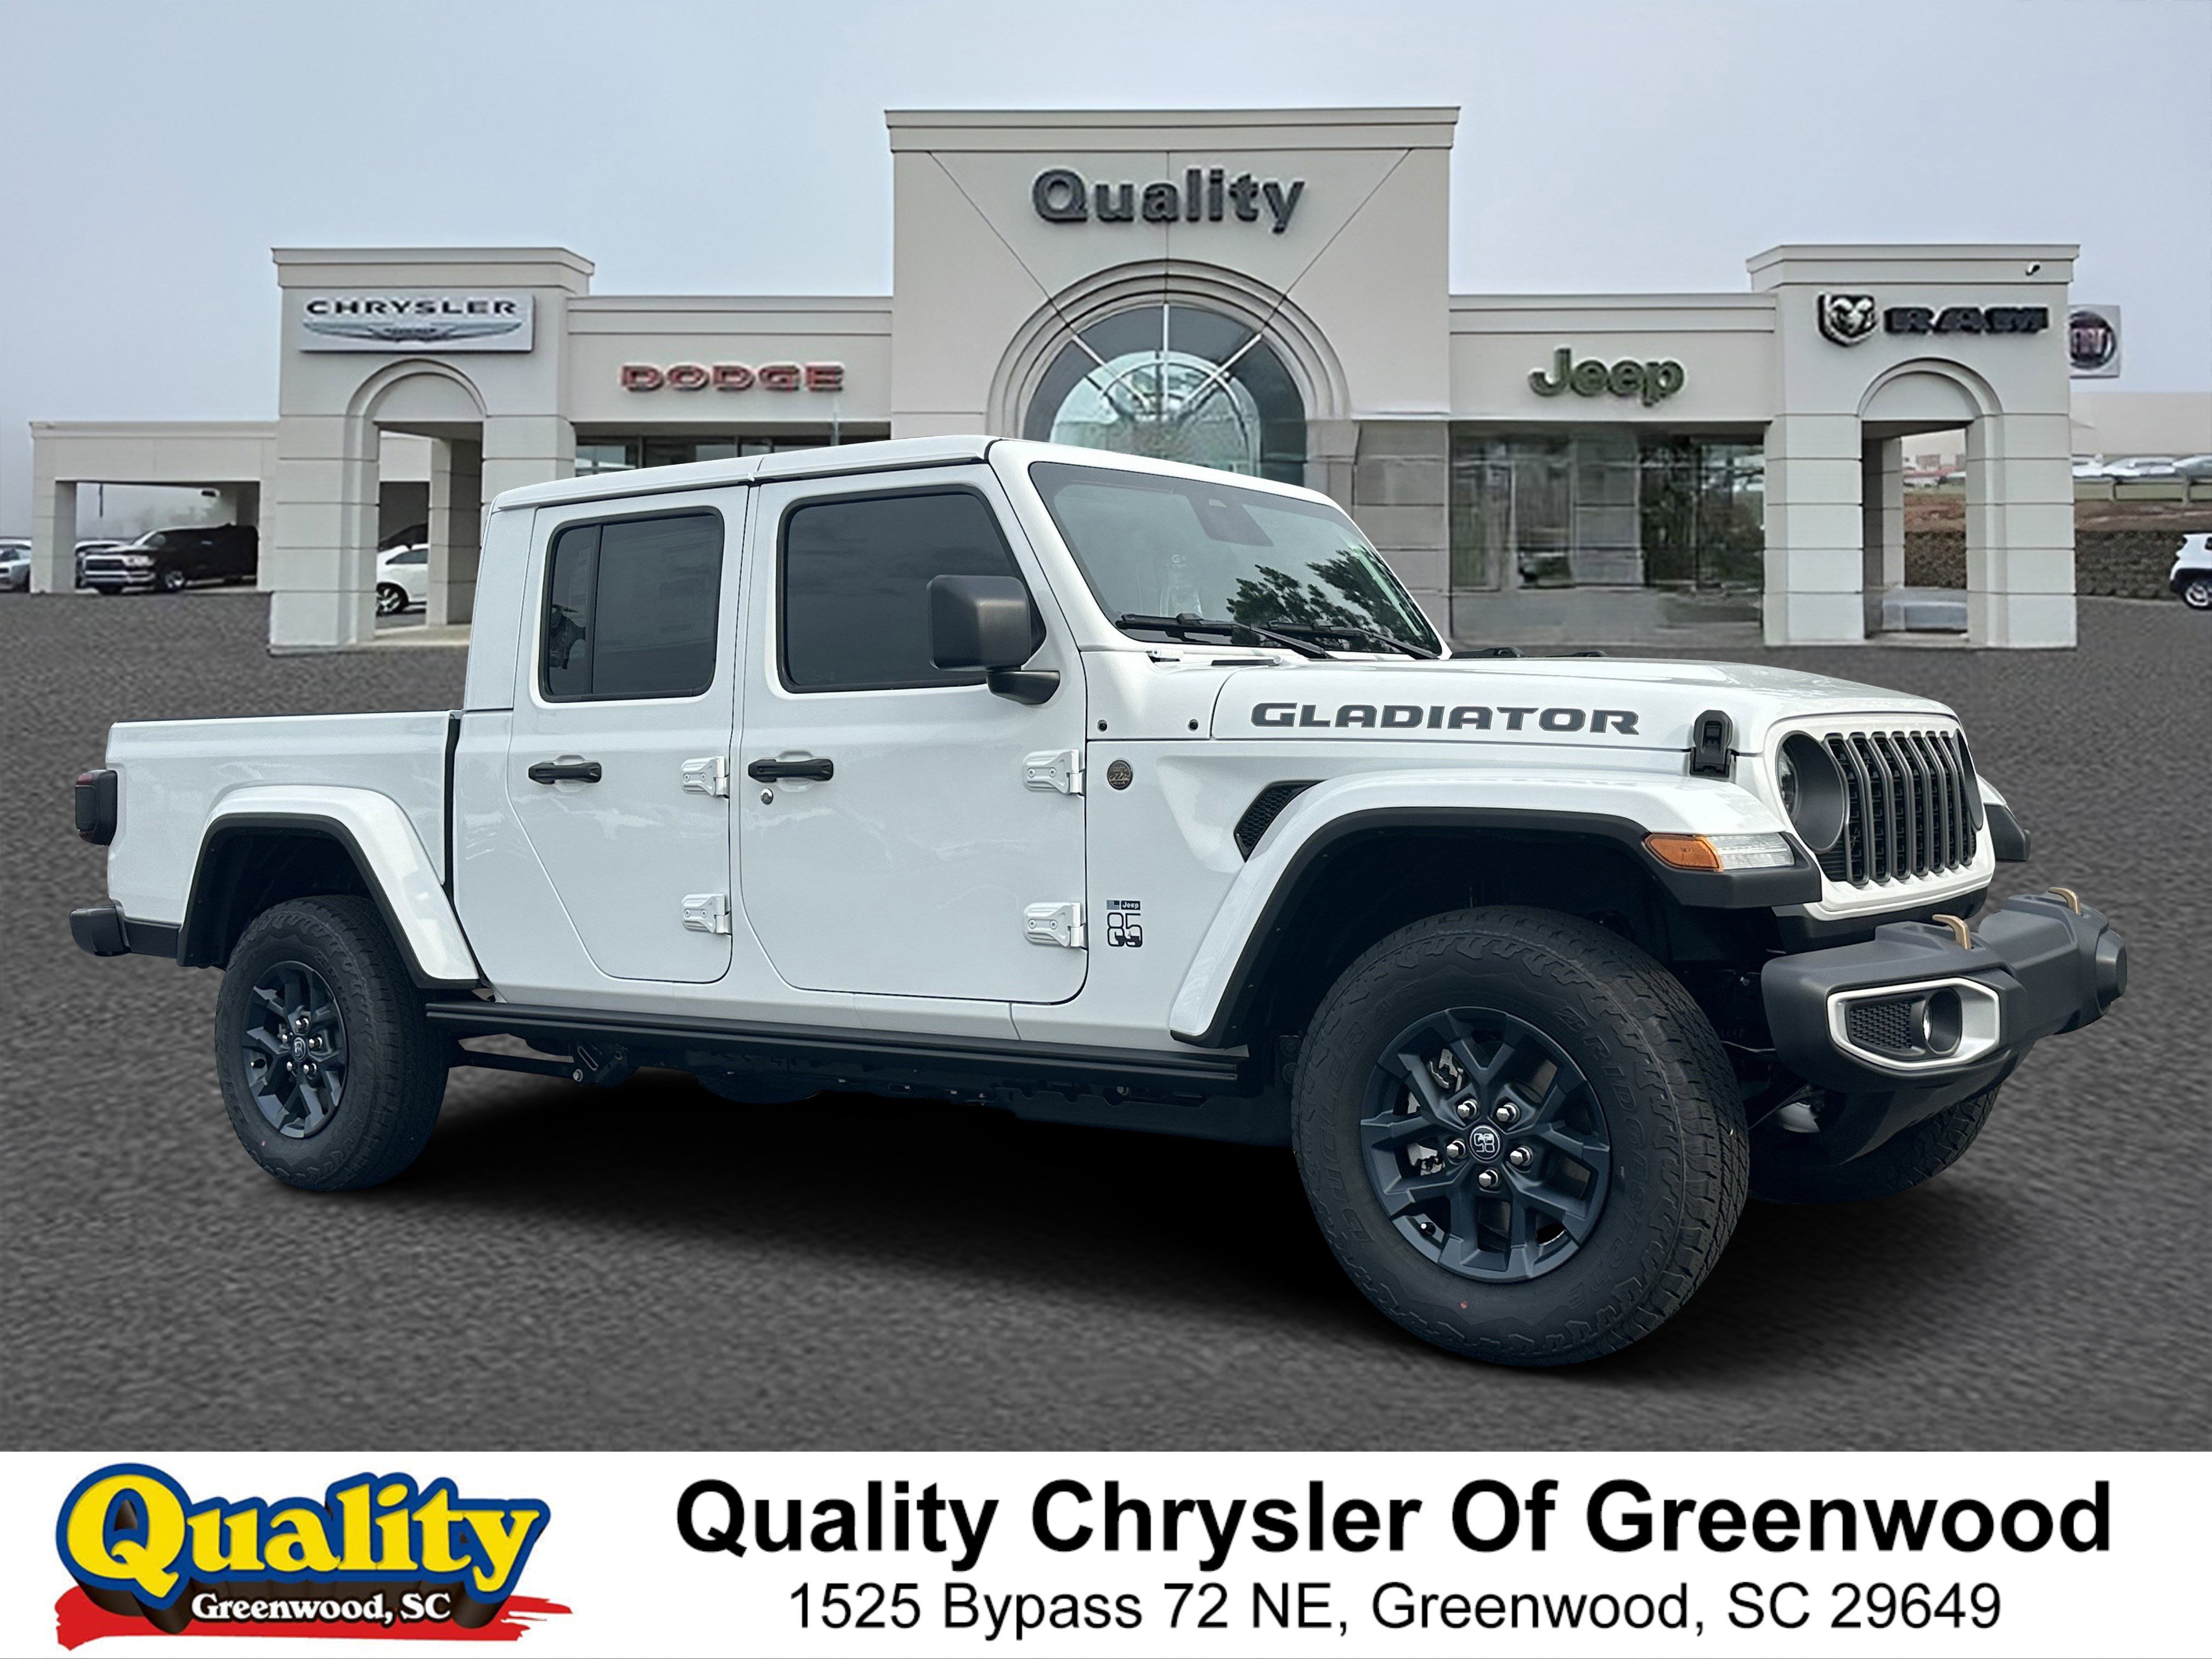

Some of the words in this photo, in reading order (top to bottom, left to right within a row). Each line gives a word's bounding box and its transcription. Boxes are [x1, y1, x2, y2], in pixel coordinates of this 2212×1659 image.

[1032, 168, 1305, 234] Quality
[306, 300, 517, 315] CHRYSLER
[1884, 307, 2049, 334] RAM
[620, 363, 845, 392] DODGE
[1528, 348, 1685, 408] Jeep
[1251, 702, 1640, 736] GLADIATOR
[1107, 912, 1143, 947] 85
[1555, 1005, 1646, 1310] BRIDGESTONE
